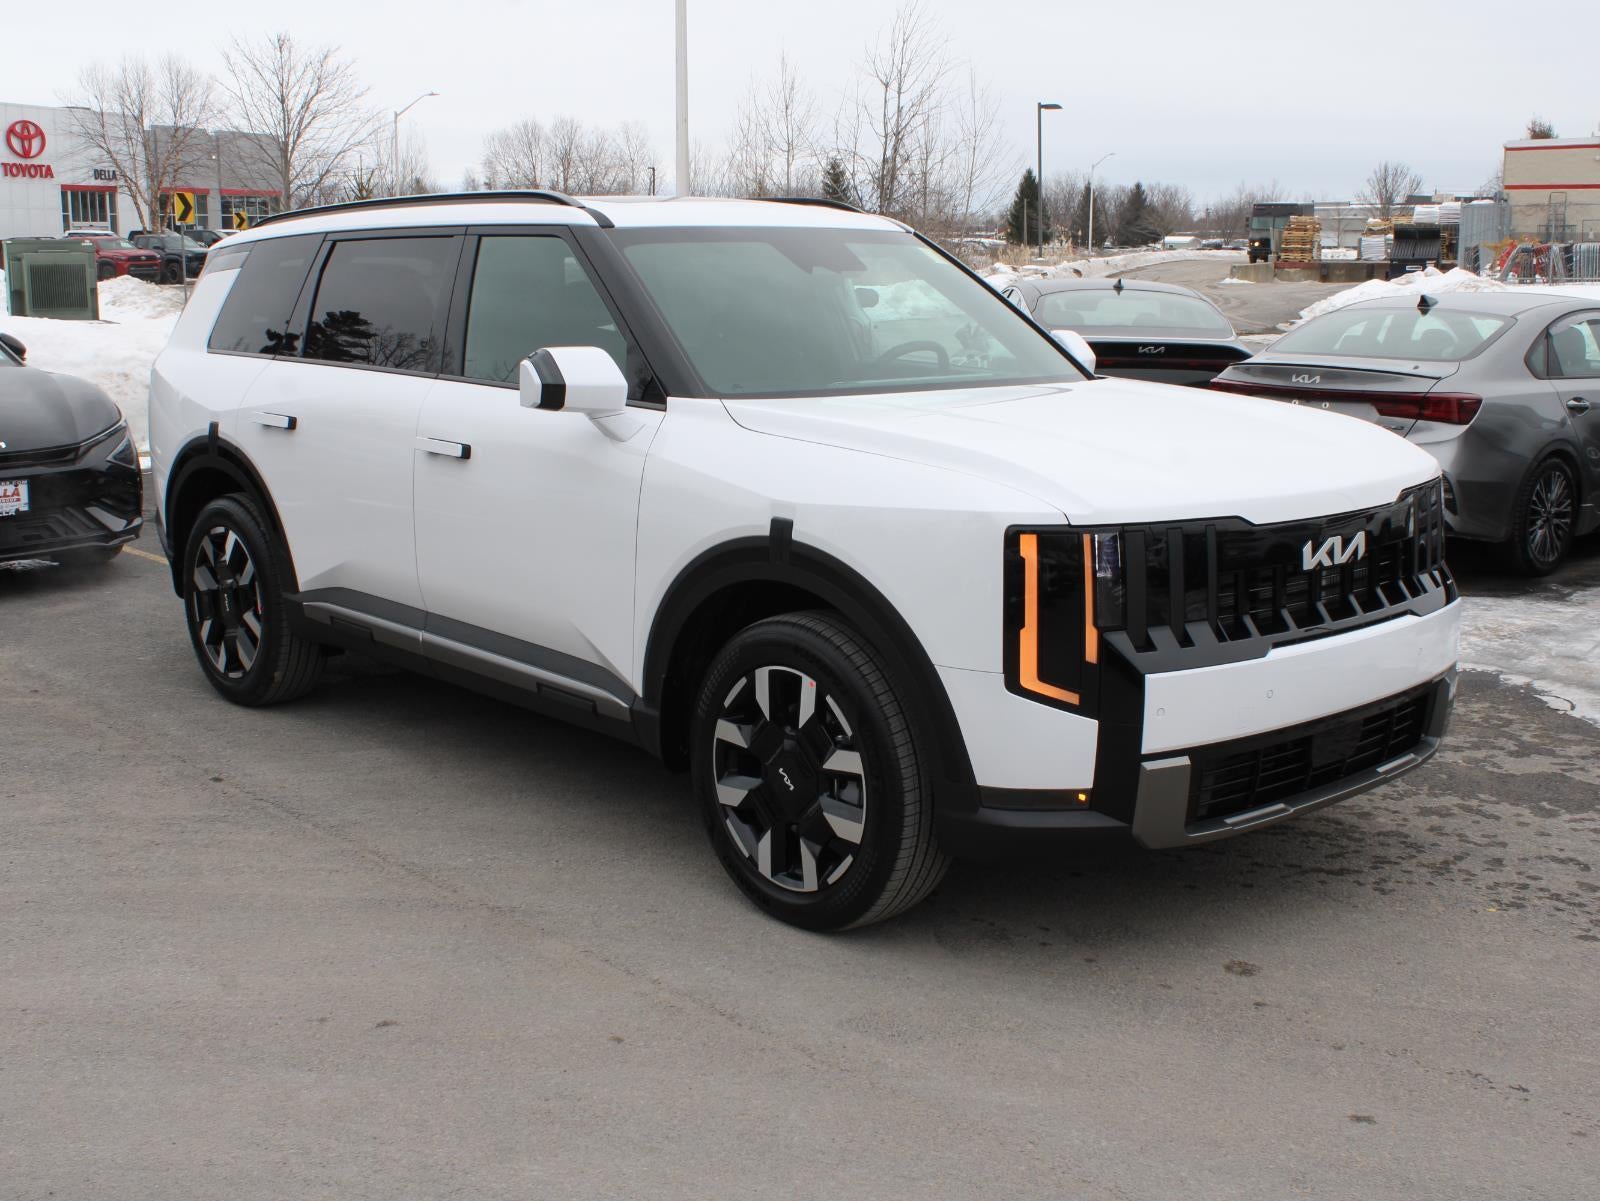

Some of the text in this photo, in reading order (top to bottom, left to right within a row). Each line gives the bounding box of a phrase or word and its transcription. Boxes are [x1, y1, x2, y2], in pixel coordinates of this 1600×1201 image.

[1, 162, 54, 179] TOYOTA
[94, 168, 118, 181] DELLA
[1292, 373, 1321, 385] KIA
[1302, 530, 1366, 571] KIA
